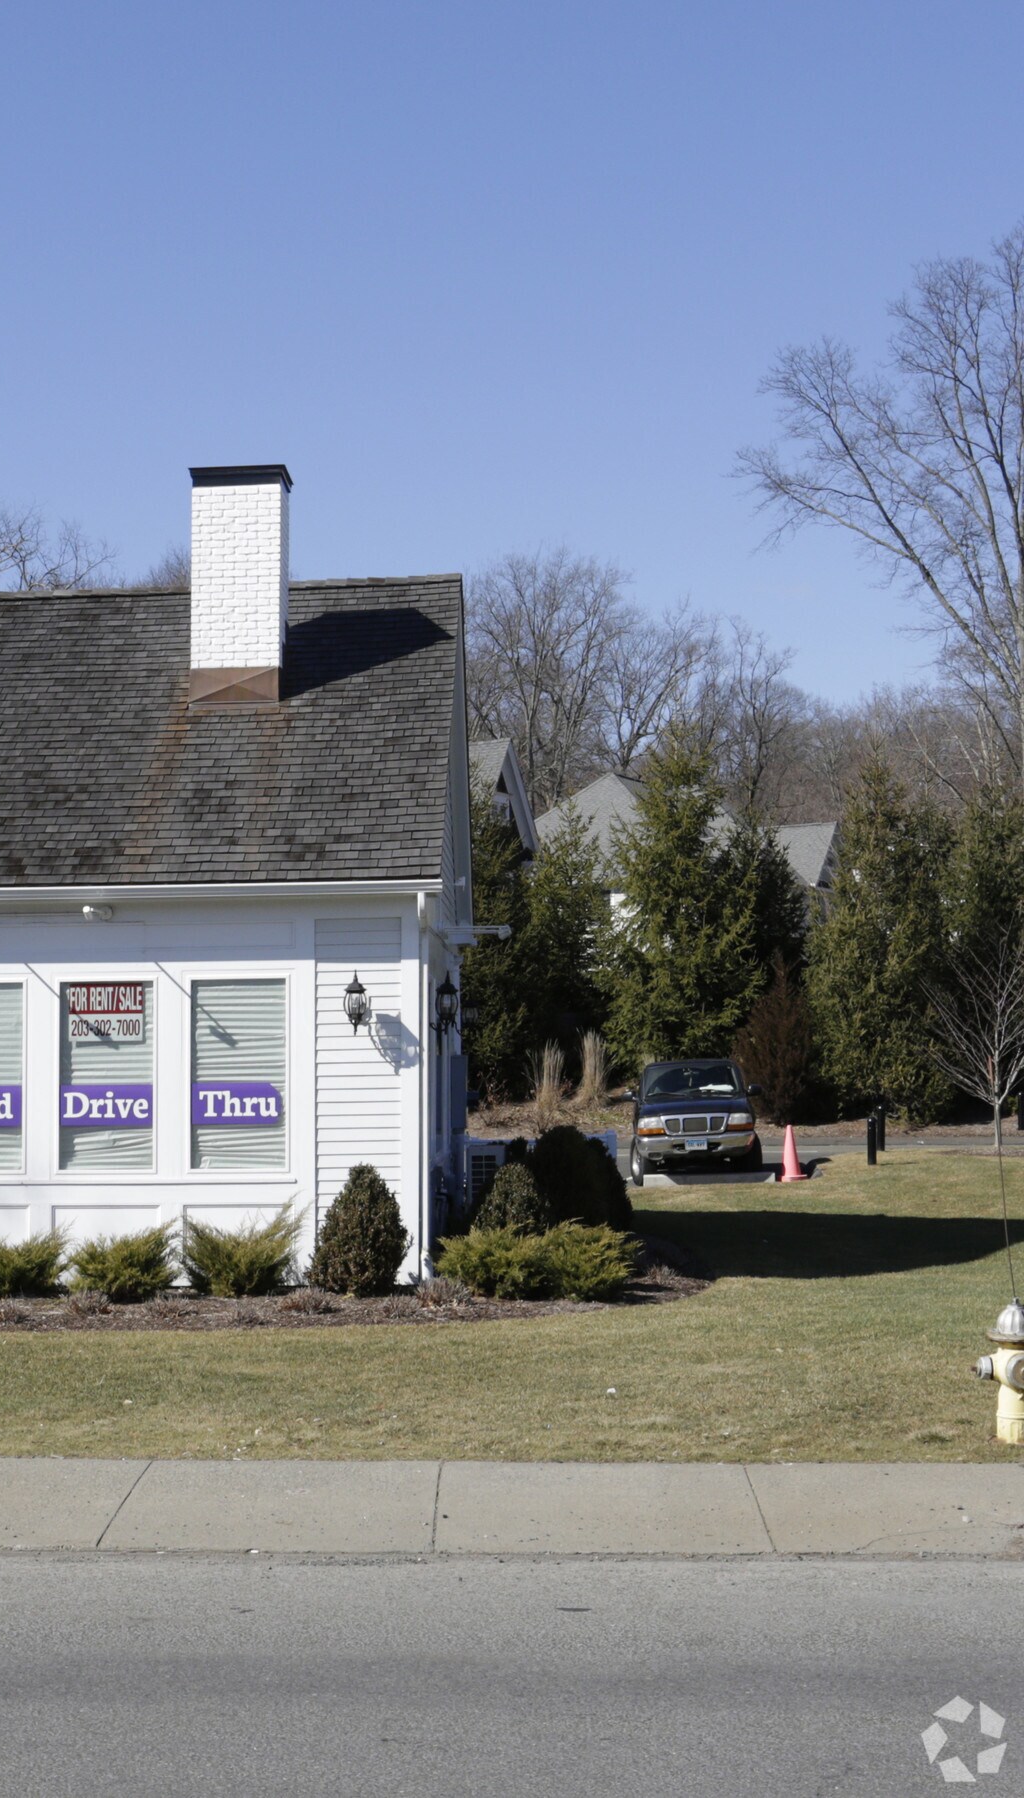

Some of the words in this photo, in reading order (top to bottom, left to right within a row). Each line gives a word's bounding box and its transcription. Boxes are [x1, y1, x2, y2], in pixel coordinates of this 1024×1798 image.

[69, 986, 88, 1011] FOR
[90, 986, 142, 1011] RENT/SALE
[71, 1019, 140, 1037] 203-302-7000
[63, 1091, 149, 1119] Drive
[199, 1091, 278, 1118] Thru
